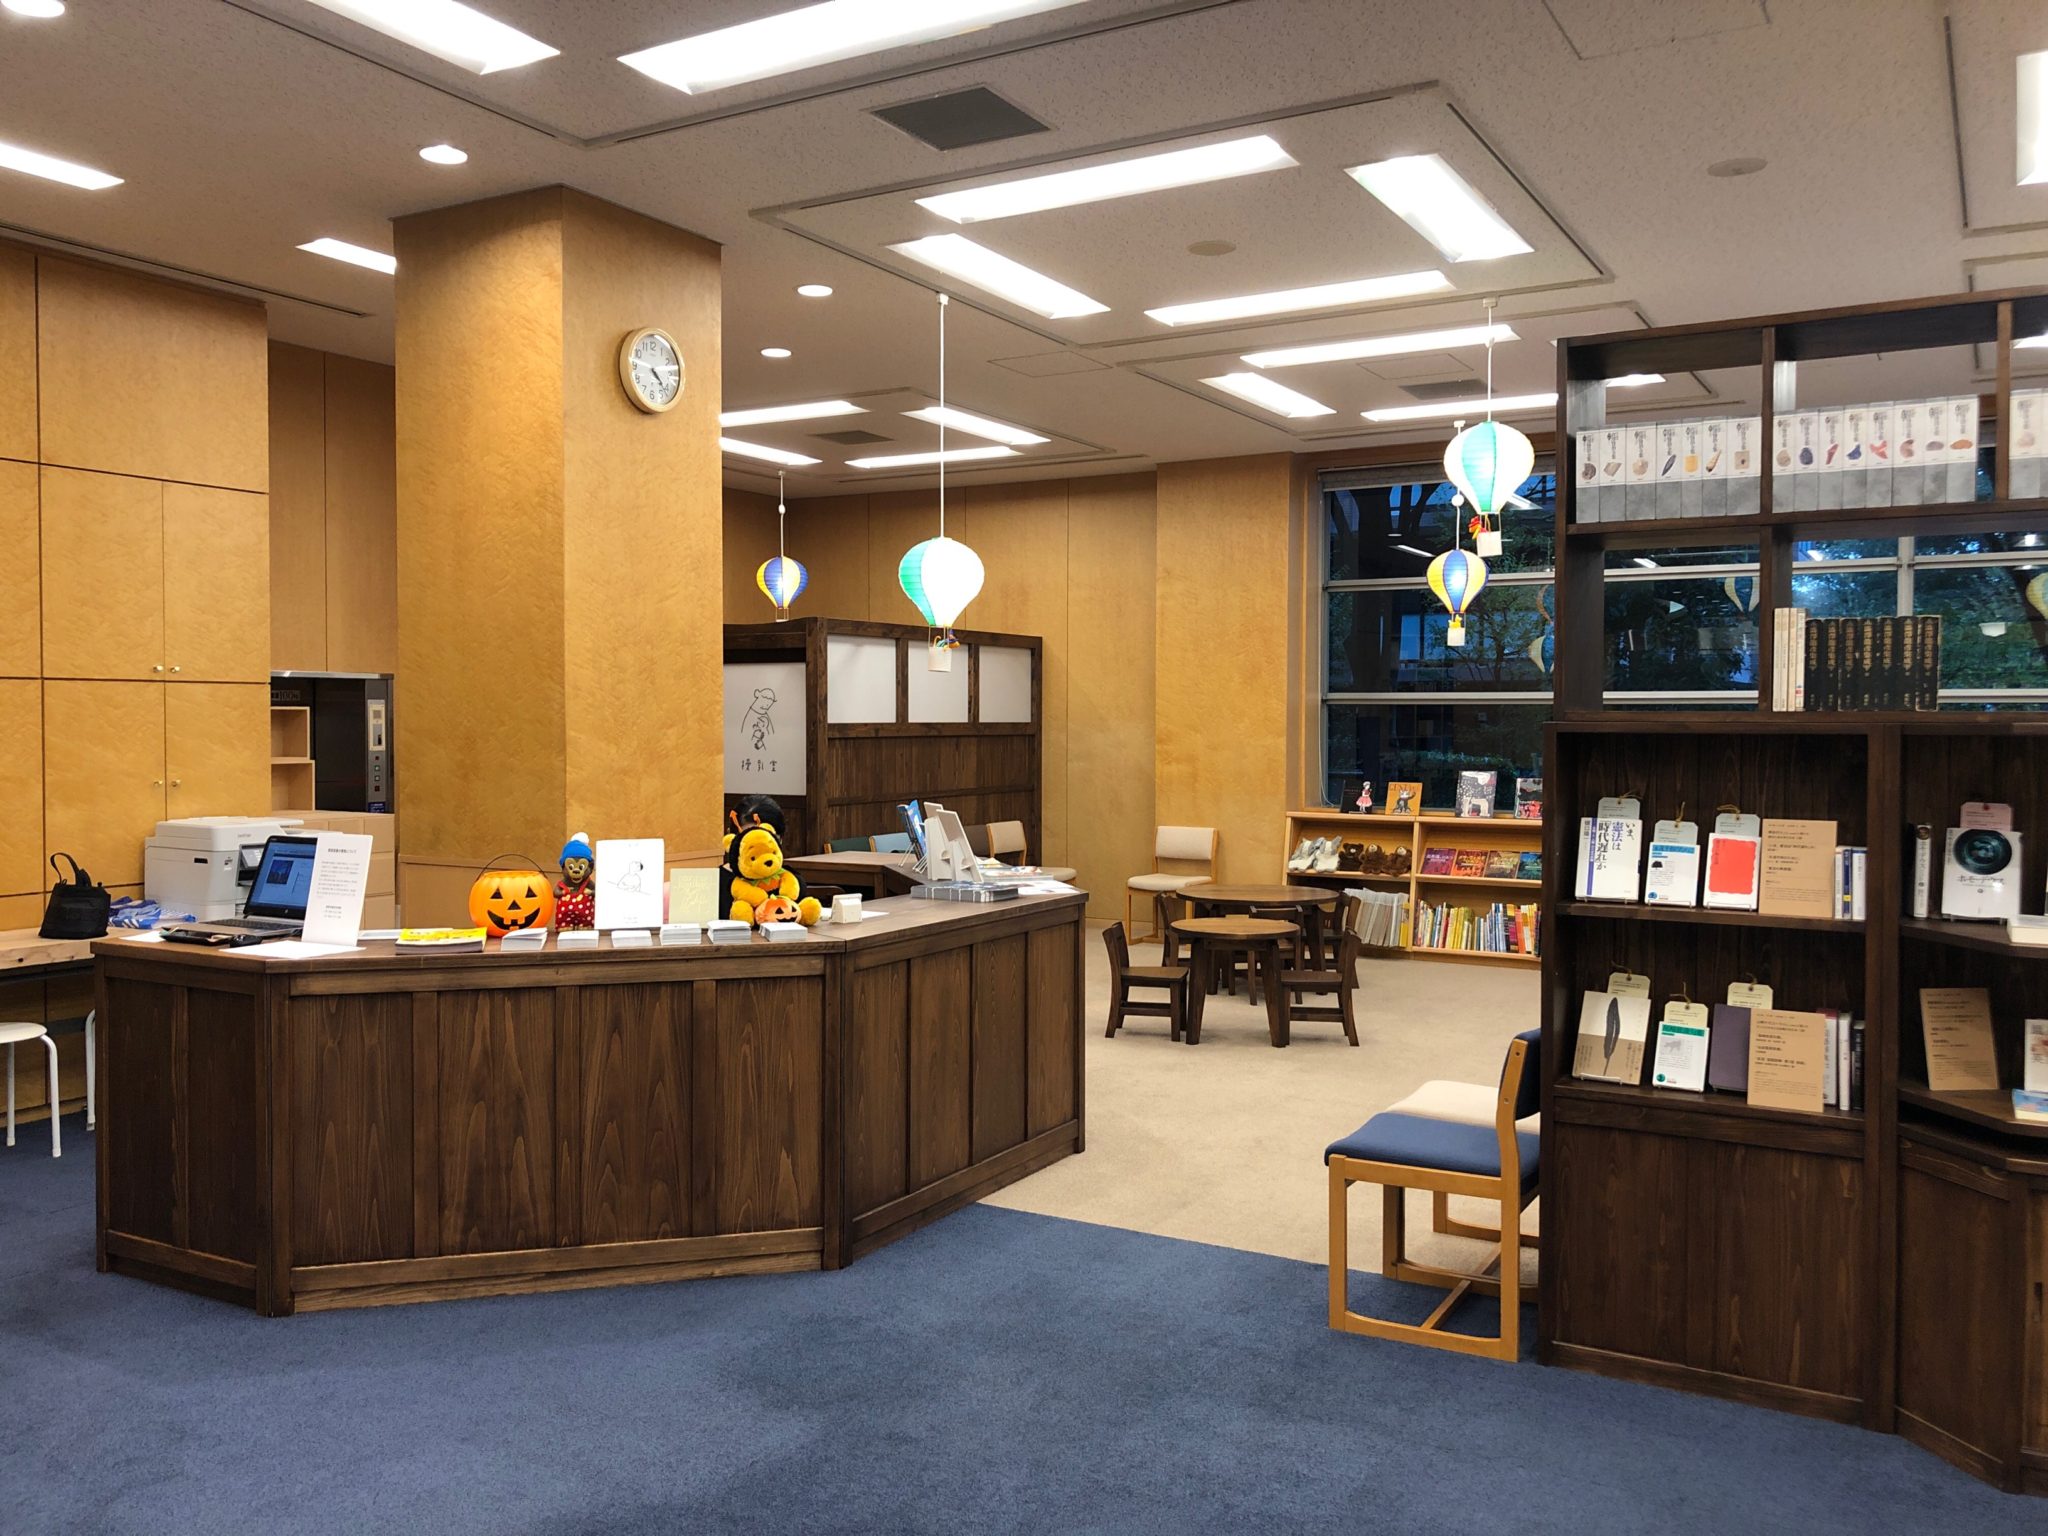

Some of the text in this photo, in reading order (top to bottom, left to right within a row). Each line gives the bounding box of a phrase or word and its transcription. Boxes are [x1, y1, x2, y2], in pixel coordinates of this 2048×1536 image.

[642, 342, 648, 352] 11
[650, 341, 656, 351] 12
[635, 348, 642, 359] 10
[649, 390, 655, 400] 6
